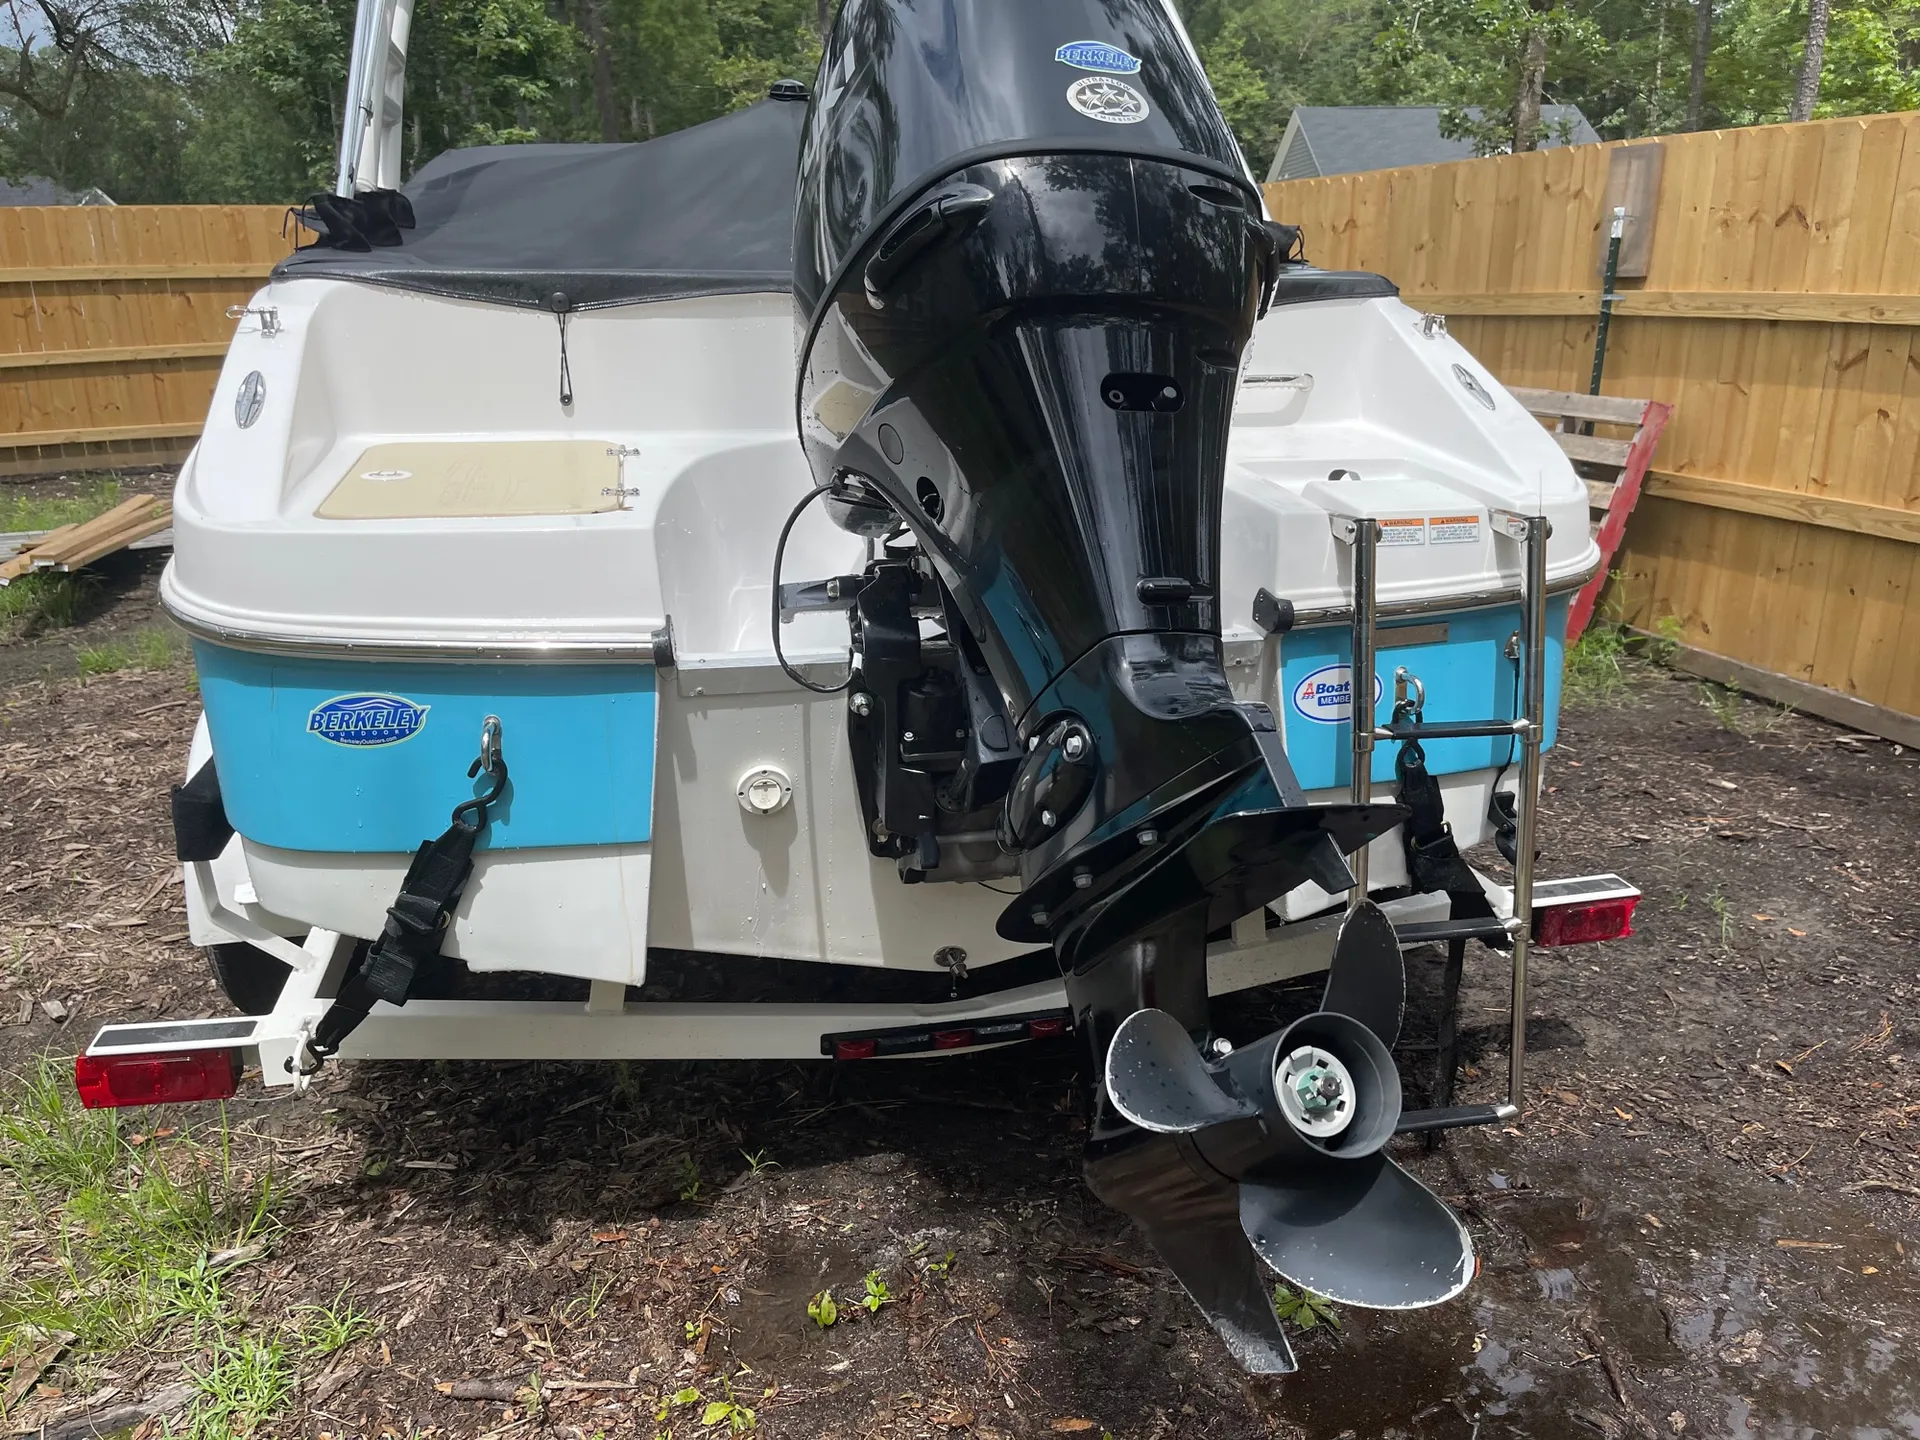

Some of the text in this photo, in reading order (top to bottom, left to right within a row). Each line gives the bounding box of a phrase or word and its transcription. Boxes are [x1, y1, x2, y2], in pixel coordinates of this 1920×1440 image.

[1057, 48, 1139, 69] BERKELEY
[1320, 694, 1350, 704] MEMBE
[309, 708, 426, 731] BERKELEY
[328, 729, 410, 737] OUTDOORS
